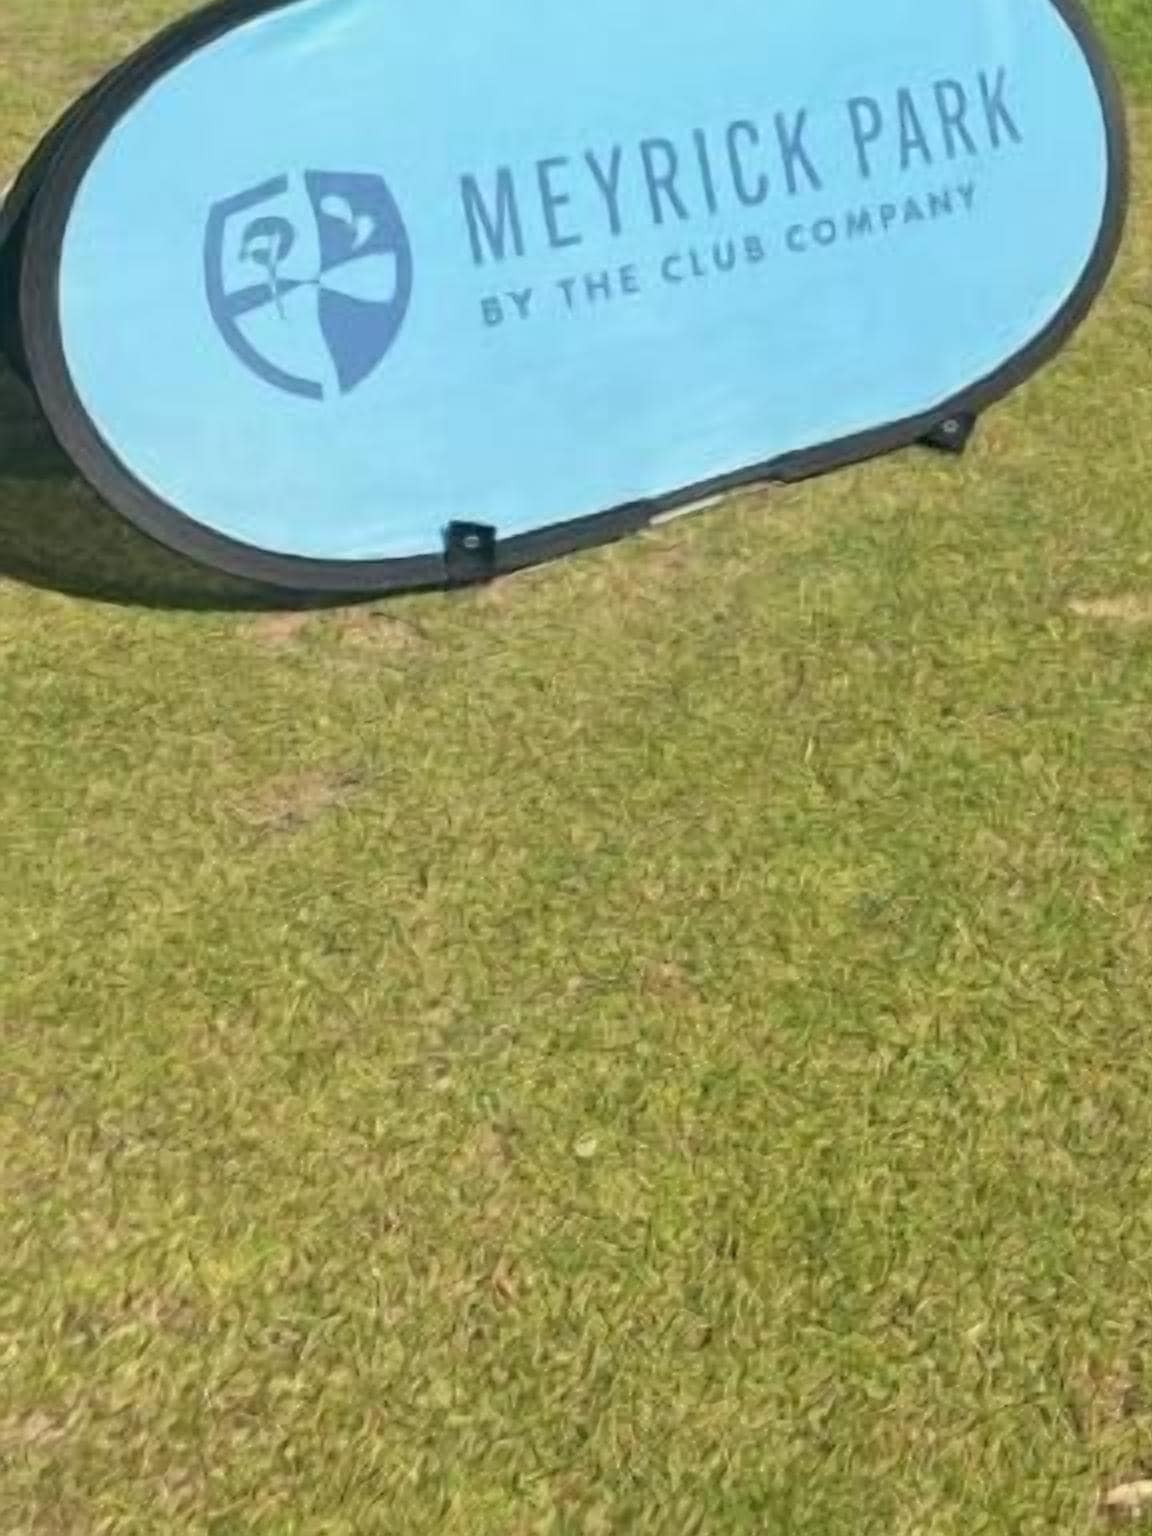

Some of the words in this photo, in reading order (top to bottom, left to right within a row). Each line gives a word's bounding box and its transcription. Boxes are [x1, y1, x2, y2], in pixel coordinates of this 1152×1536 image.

[457, 104, 825, 270] MEYRICK
[844, 66, 1025, 182] PARK
[479, 287, 533, 330] BY
[554, 263, 641, 312] THE
[660, 233, 767, 285] CLUB
[783, 177, 978, 254] COMPANY
